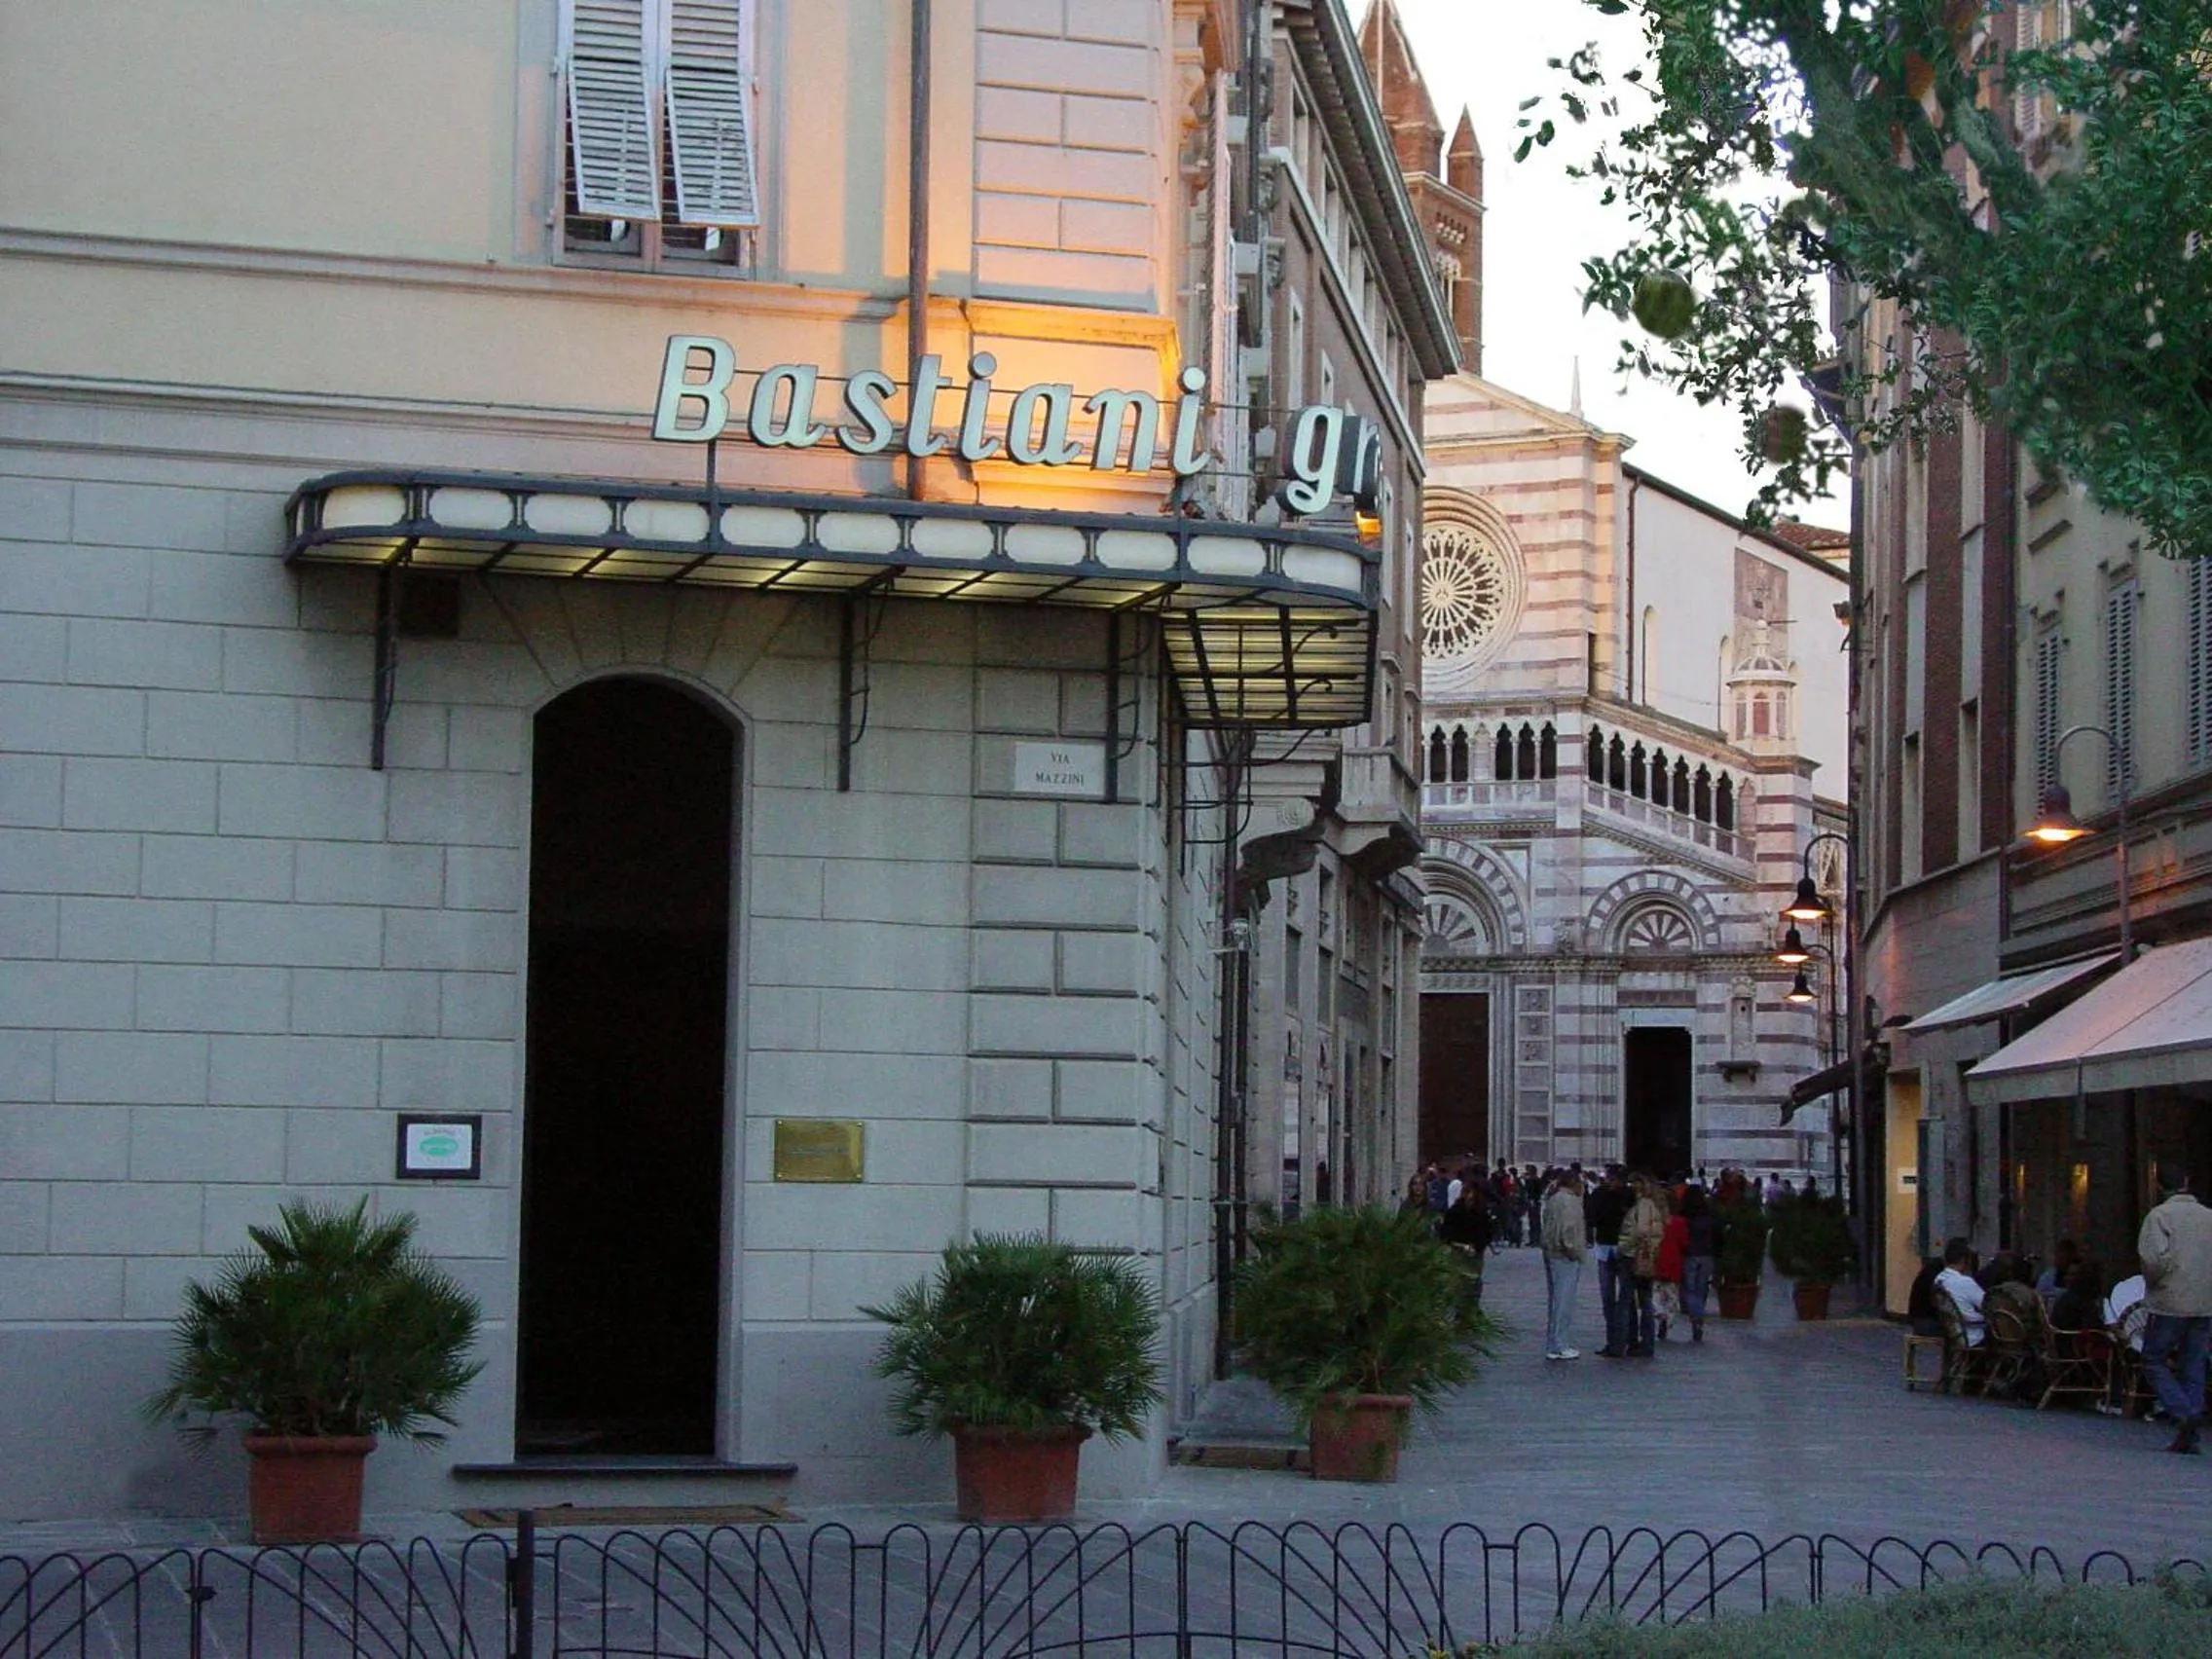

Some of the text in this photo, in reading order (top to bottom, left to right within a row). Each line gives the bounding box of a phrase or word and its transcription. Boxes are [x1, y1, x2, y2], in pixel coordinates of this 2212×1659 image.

[651, 334, 1383, 516] Bastiani gr
[1051, 753, 1070, 764] VIA
[1035, 771, 1085, 787] MAZZINI
